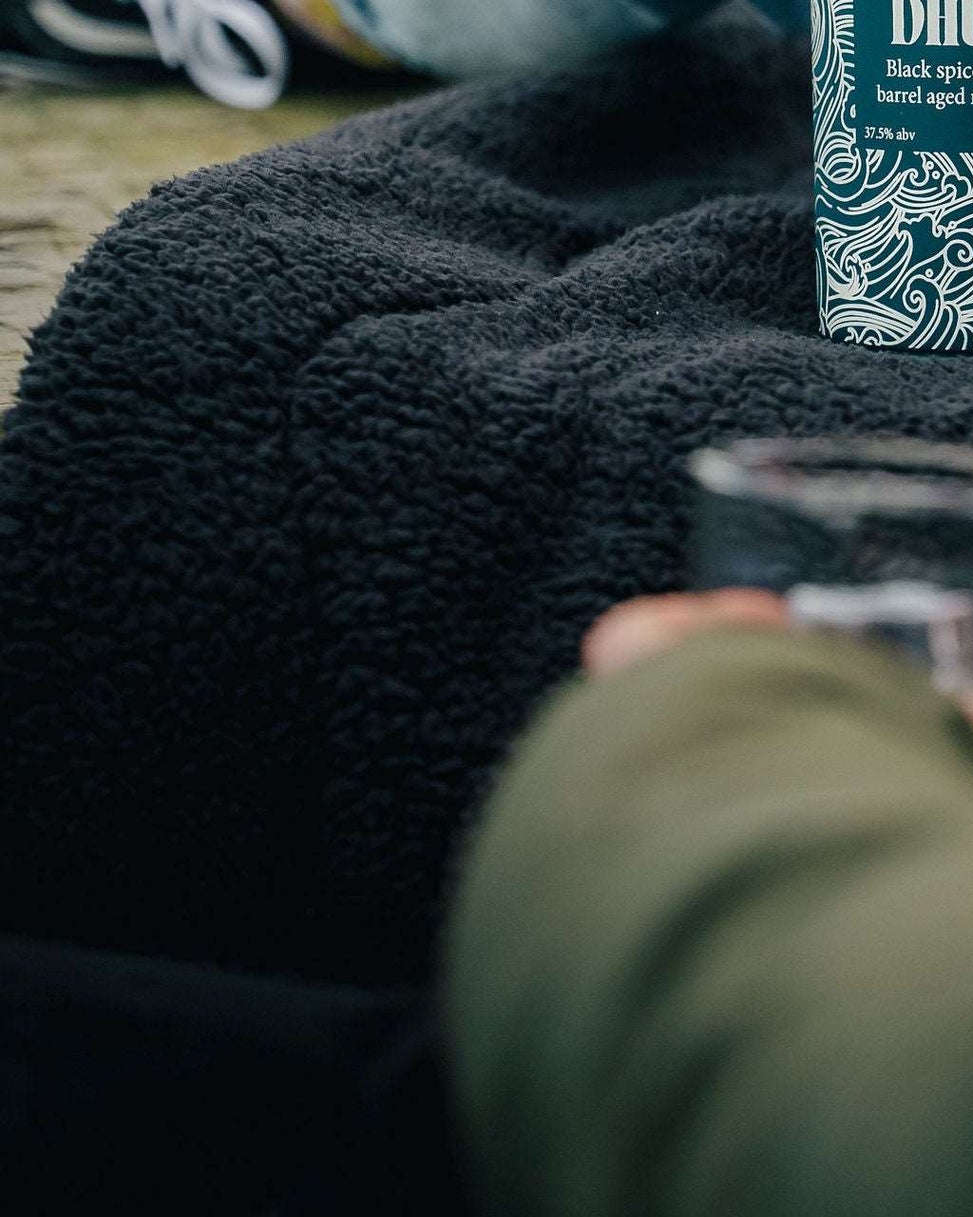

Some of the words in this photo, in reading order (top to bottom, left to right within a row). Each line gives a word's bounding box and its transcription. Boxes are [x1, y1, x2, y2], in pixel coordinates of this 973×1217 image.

[886, 58, 931, 78] Black
[876, 84, 922, 103] barrel
[926, 87, 966, 109] aged
[865, 127, 894, 140] 37.5%
[896, 127, 915, 141] abv
